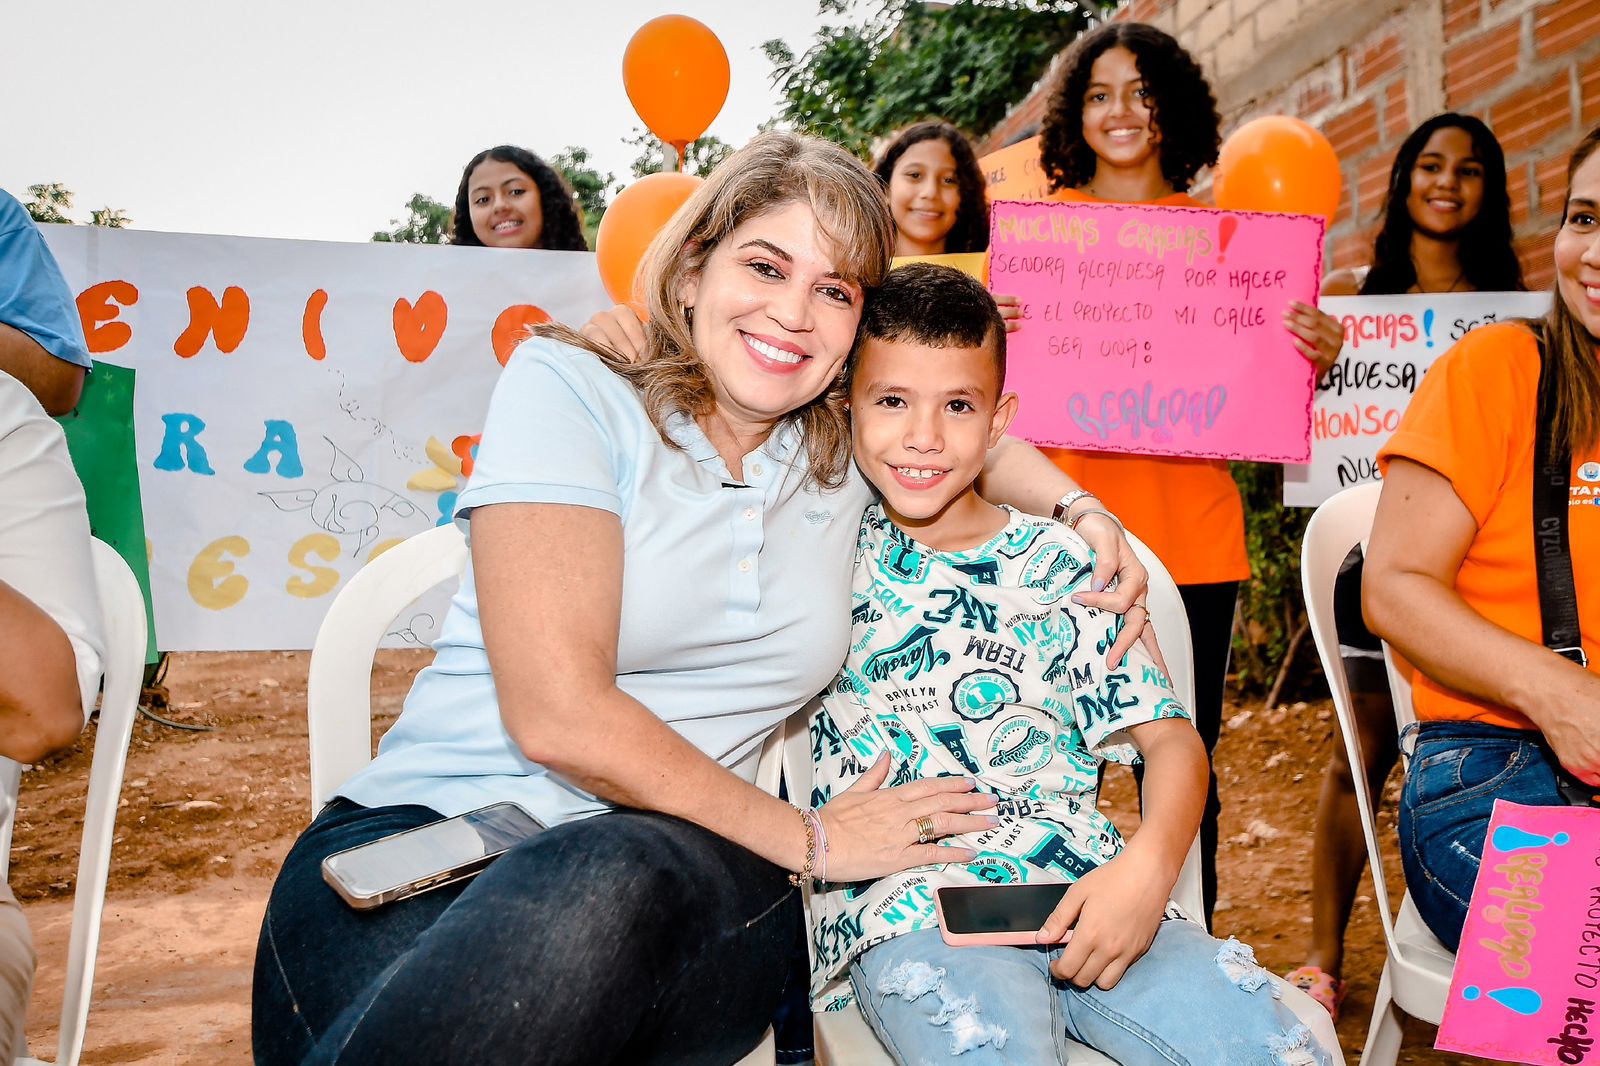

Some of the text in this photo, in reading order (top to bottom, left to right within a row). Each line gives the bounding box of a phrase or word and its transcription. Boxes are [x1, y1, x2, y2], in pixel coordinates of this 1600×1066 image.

[998, 213, 1099, 255] MUCHAS
[1079, 260, 1165, 291] ALCALDESA
[1185, 267, 1217, 288] POR
[1229, 270, 1287, 301] HACER
[1045, 301, 1063, 322] EL
[1073, 300, 1152, 324] PROYECTO
[1175, 306, 1196, 325] MI
[1213, 307, 1265, 334] CALLE
[1332, 308, 1435, 348] ACIAS!
[1048, 335, 1082, 359] SEA
[1067, 382, 1228, 441] REALIDAD
[145, 533, 406, 611] ES
[962, 635, 1027, 673] TEAM
[885, 686, 937, 703] BRKLYN
[892, 699, 940, 714] EAS OAST
[873, 887, 905, 917] AUTHENTIC
[902, 875, 928, 895] RACING
[881, 884, 934, 927] NYC
[1547, 997, 1596, 1065] HECHO
